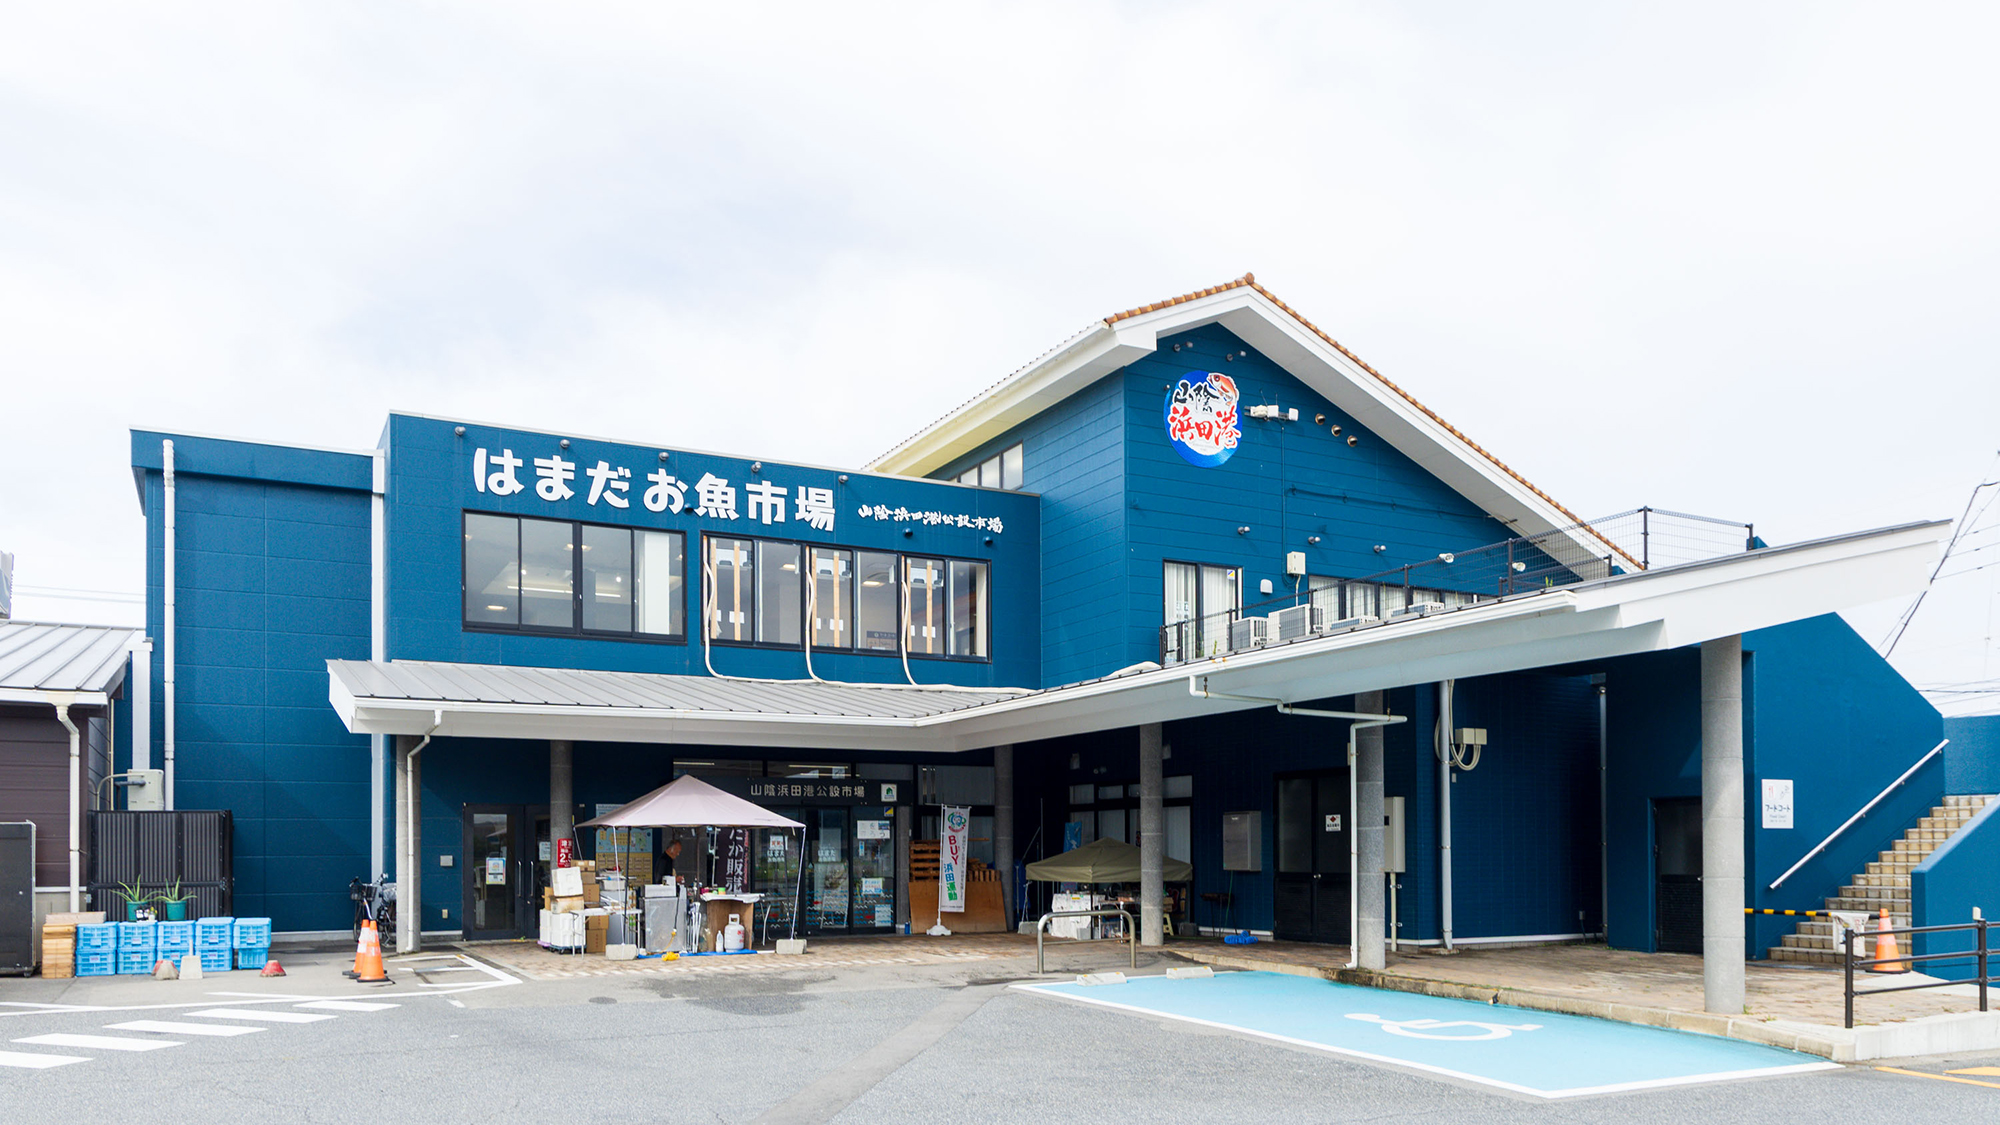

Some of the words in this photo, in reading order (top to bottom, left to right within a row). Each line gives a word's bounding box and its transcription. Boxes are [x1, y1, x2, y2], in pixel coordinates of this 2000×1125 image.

[1169, 405, 1240, 447] 浜田港
[473, 446, 836, 532] はまだお魚市場
[750, 784, 865, 799] 山陰浜田港公設市場
[948, 834, 960, 866] BUY
[943, 862, 958, 902] 浜田運動
